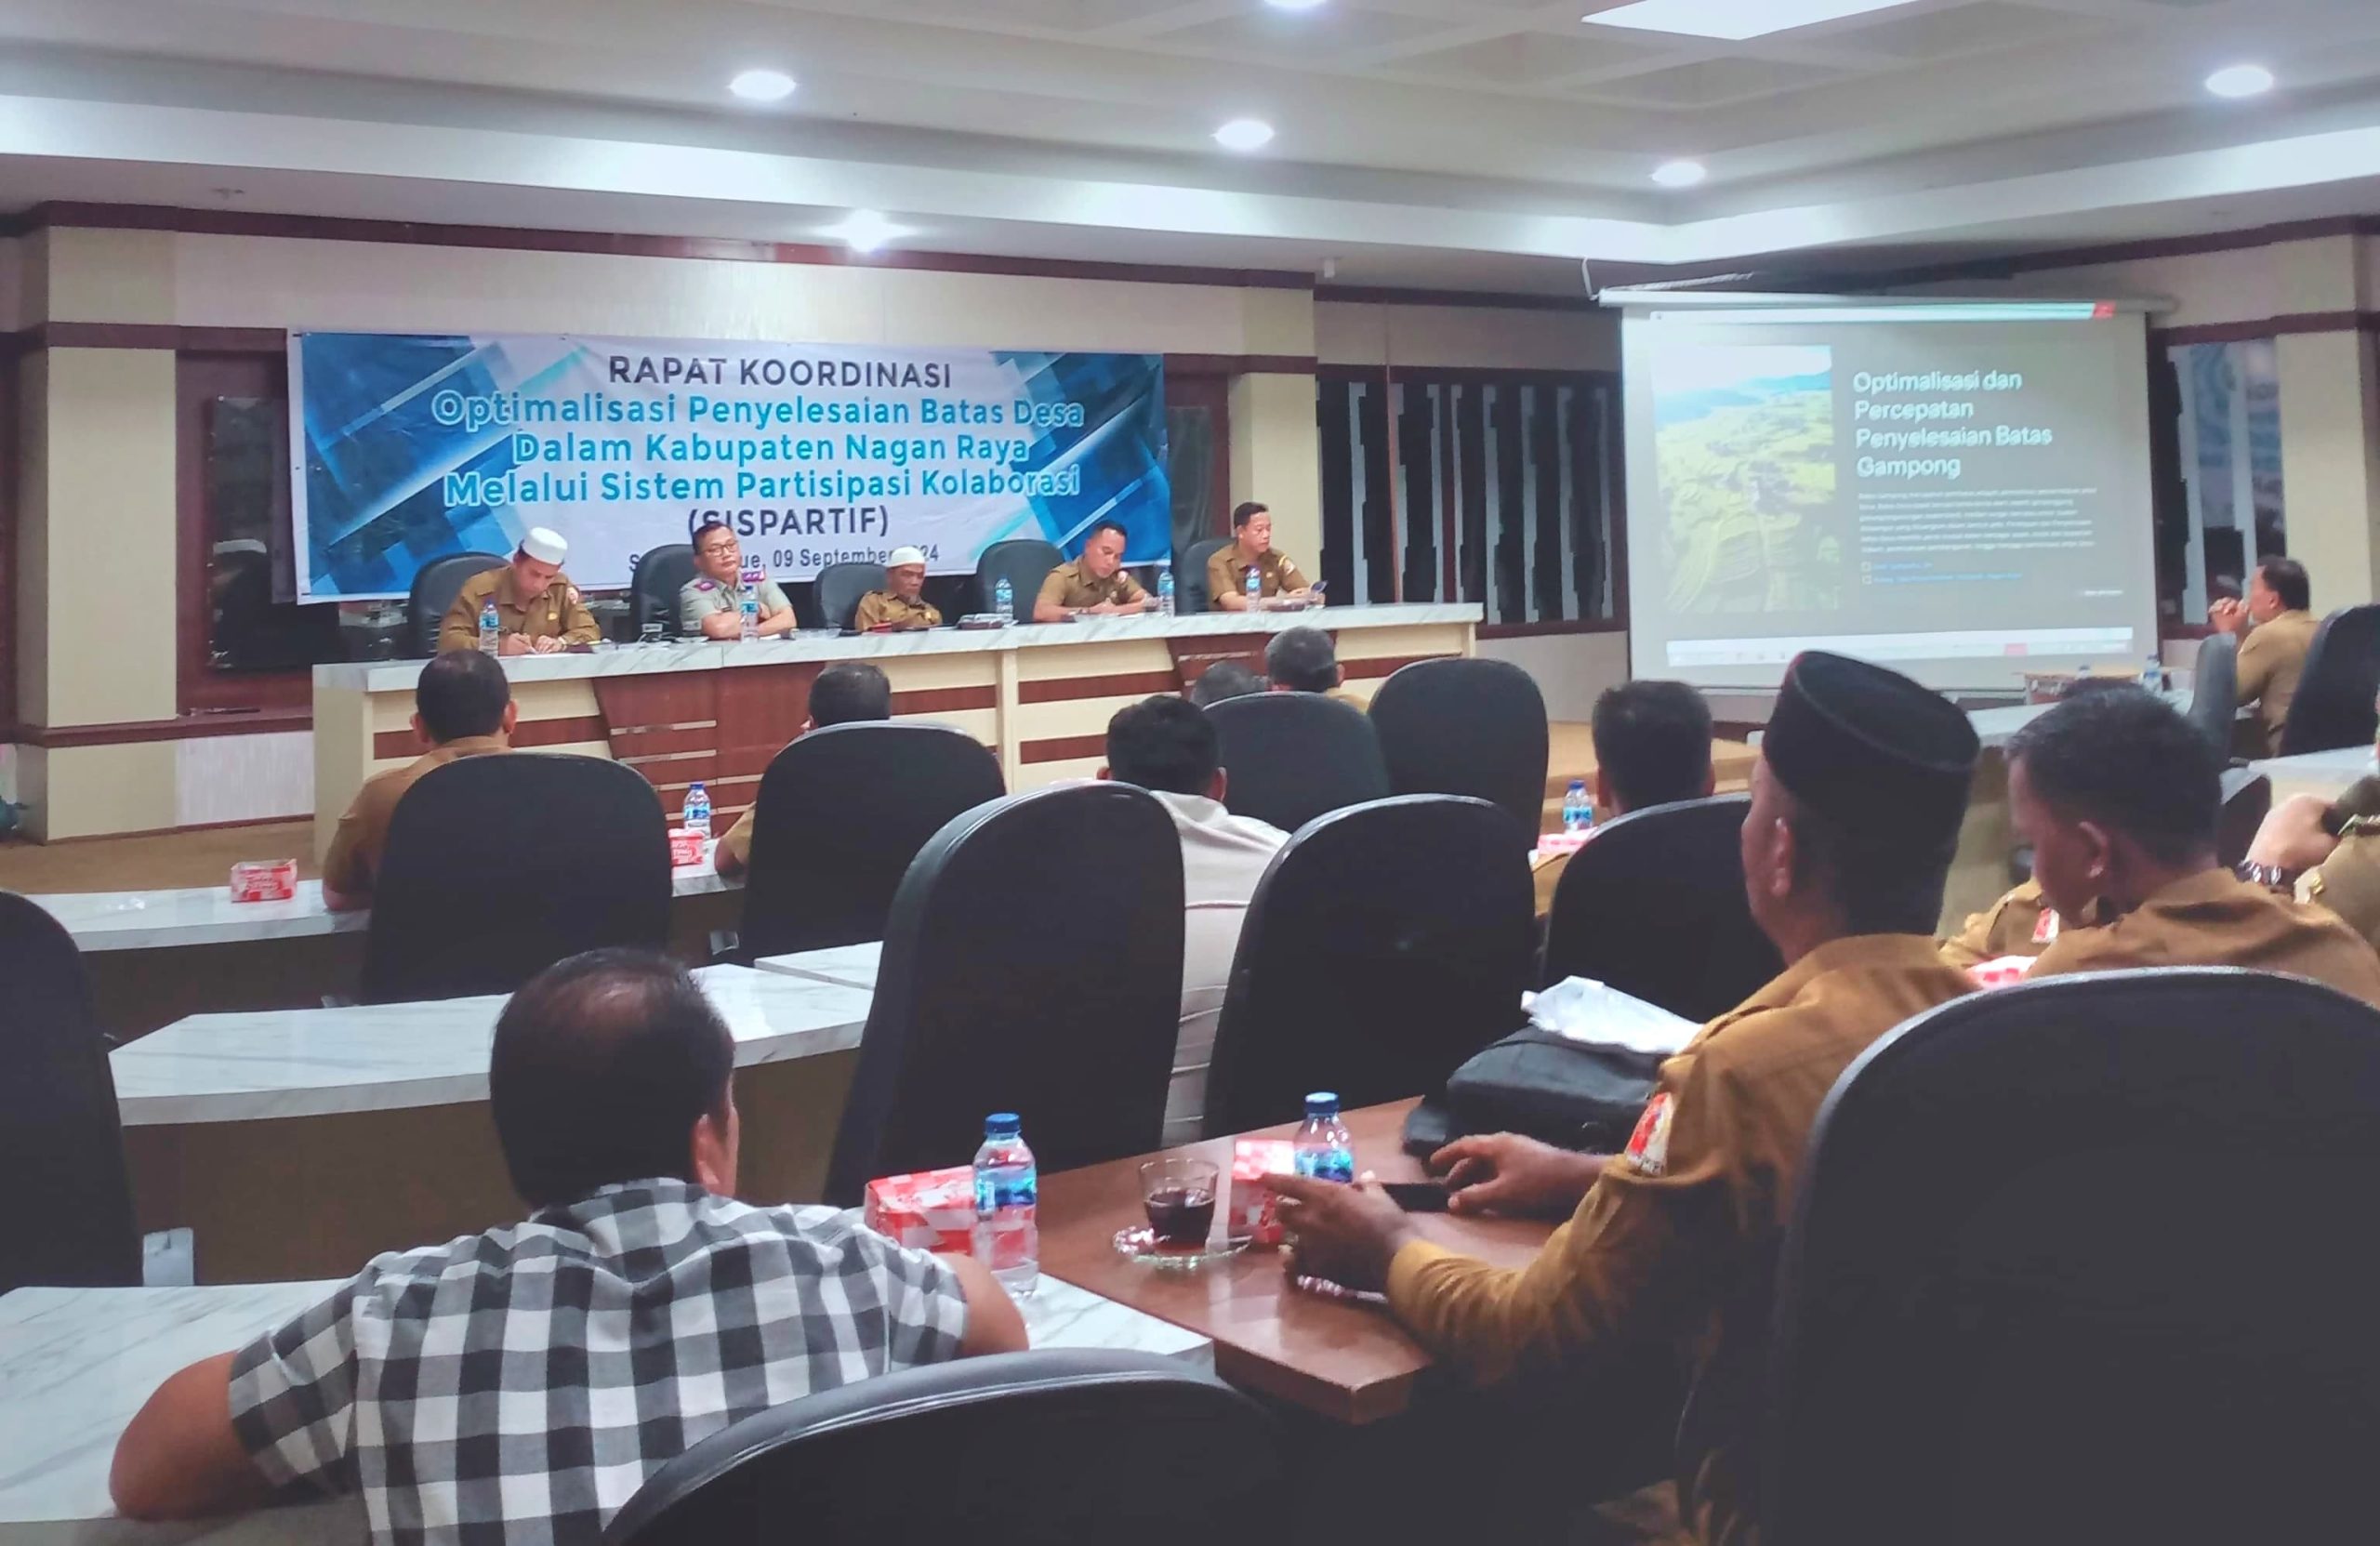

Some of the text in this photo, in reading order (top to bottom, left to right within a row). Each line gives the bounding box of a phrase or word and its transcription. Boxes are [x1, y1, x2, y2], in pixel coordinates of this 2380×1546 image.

[609, 356, 952, 389] RAPAT KOORDINASI
[1853, 369, 2023, 395] Optimalisasi dan
[432, 390, 1086, 430] Optimalisasi Penyelesaian Batas Desa
[1854, 400, 1975, 424] Percepatan
[515, 433, 1030, 470] Dalam Kabupaten Nagan Raya
[1856, 425, 2053, 452] Penyelesaian Batas
[1857, 456, 1962, 481] Gampong
[443, 464, 1080, 507] Melalui Sistem Partisipasi Kolaborasi
[773, 549, 795, 568] 09
